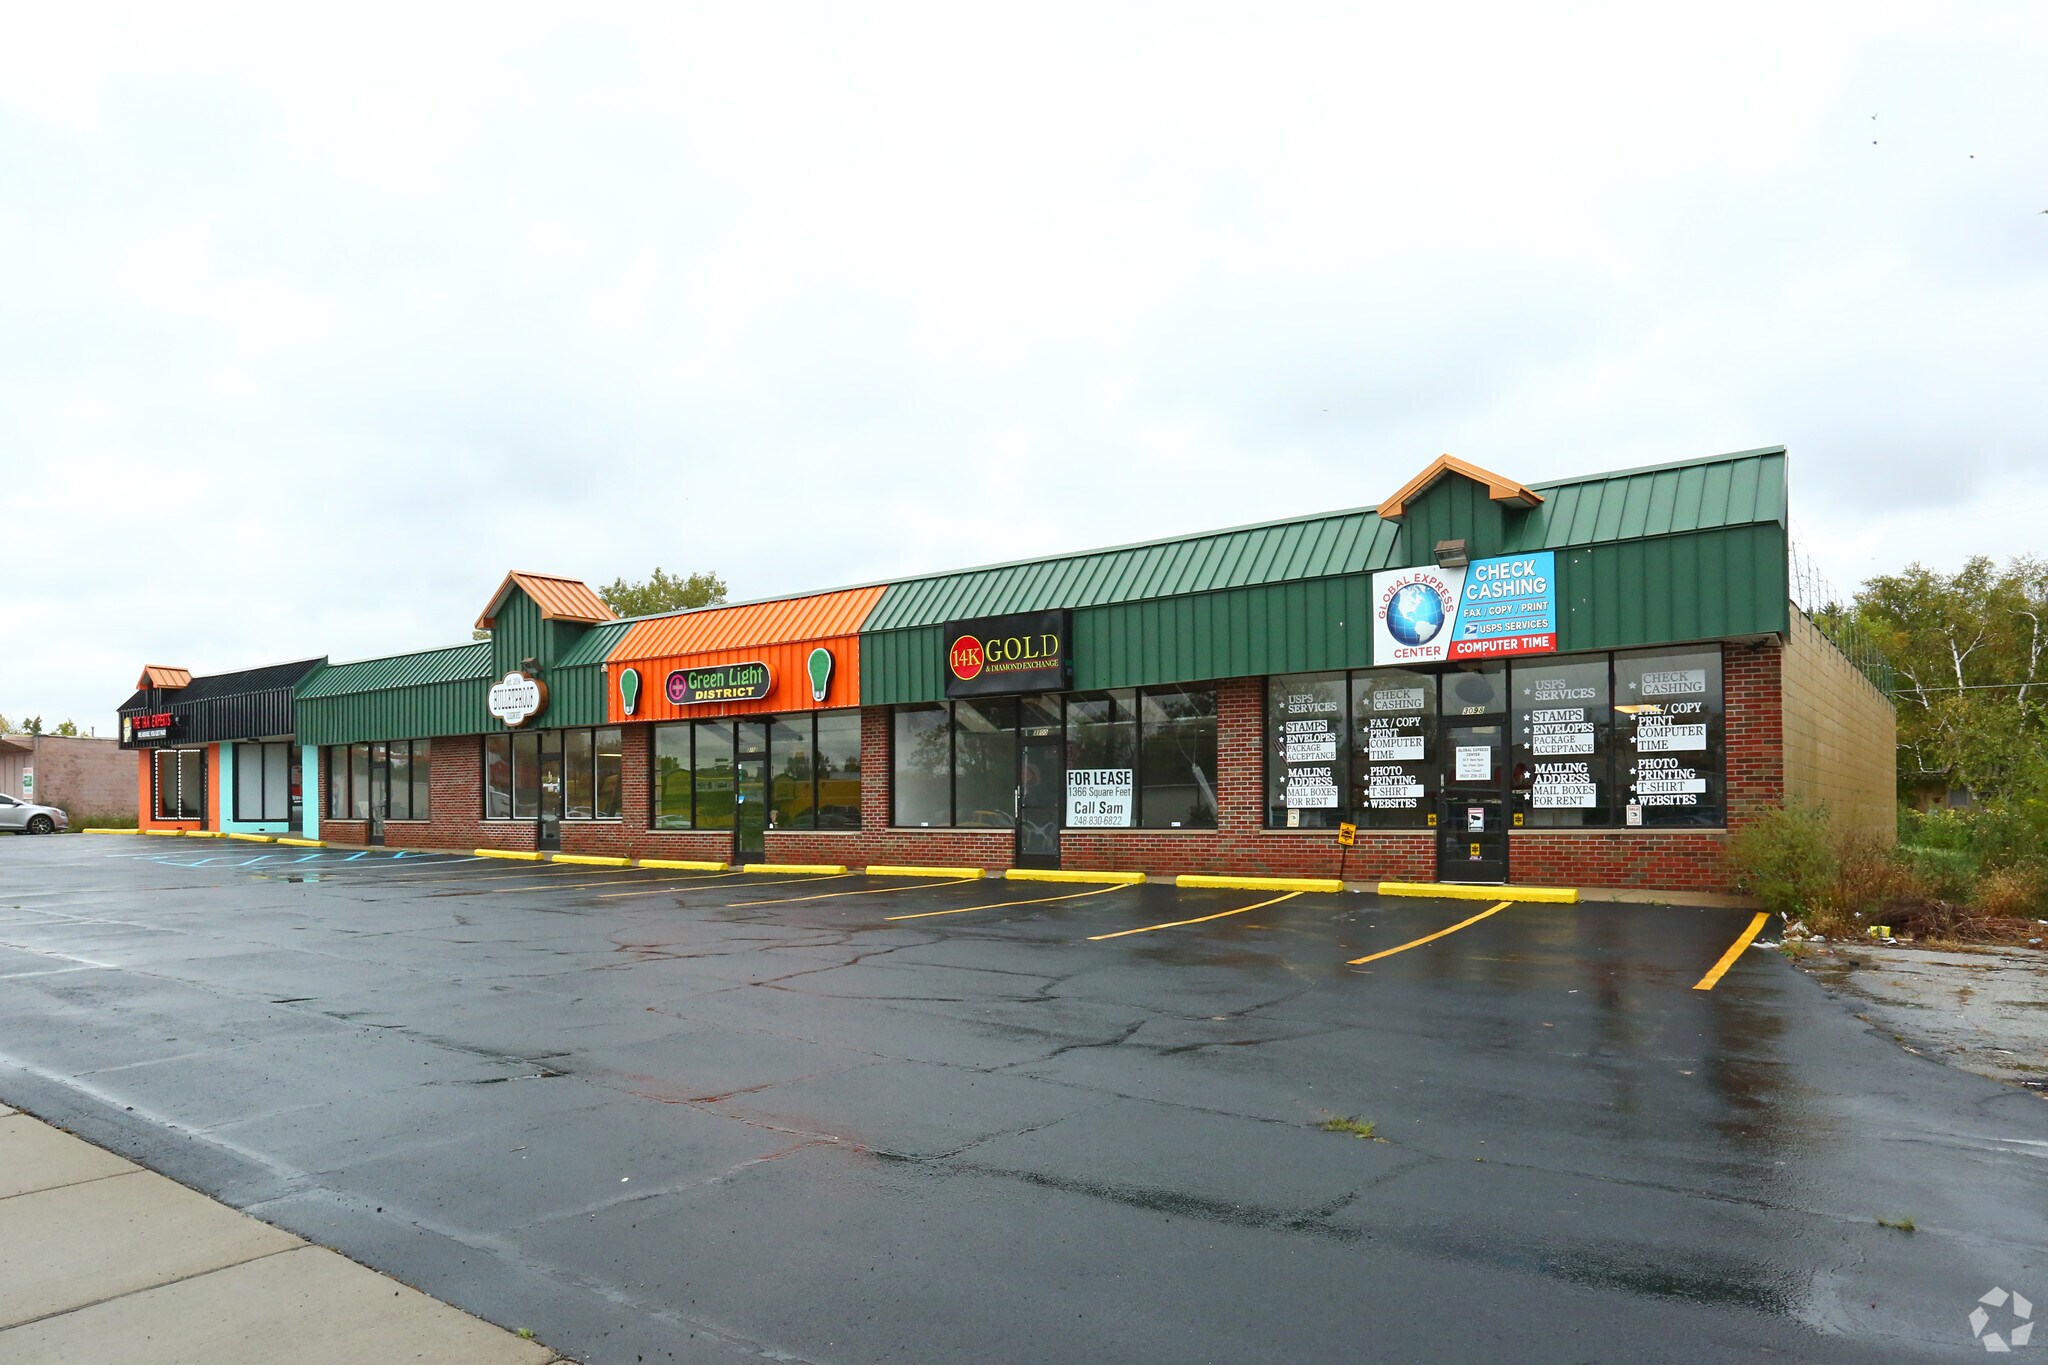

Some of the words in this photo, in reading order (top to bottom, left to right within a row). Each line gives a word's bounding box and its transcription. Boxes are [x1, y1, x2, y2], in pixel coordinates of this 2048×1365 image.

[1475, 560, 1536, 582] CHECK
[1466, 577, 1546, 600] CASHING
[1378, 576, 1410, 620] GLOBAL
[1414, 574, 1454, 612] EXPRESS
[1464, 608, 1481, 618] FAX
[1490, 605, 1512, 616] COPY
[1521, 602, 1548, 612] PRINT
[1480, 623, 1502, 633] USPS
[1504, 620, 1548, 631] SERVICES
[953, 648, 980, 667] 14K
[985, 634, 1058, 662] GOLD
[1456, 639, 1518, 654] COMPUTER
[1521, 636, 1550, 648] TIME
[1394, 646, 1440, 658] CENTER
[992, 662, 1022, 670] DIAMOND
[1023, 660, 1058, 669] EXCHANGE
[688, 672, 724, 690] Green
[729, 666, 763, 686] Light
[1643, 672, 1688, 684] CHECK
[1536, 679, 1566, 690] USPS
[1643, 682, 1702, 694] CASHING
[695, 687, 754, 700] DISTRICT
[1288, 694, 1313, 704] USPS
[1374, 690, 1410, 700] CHECK
[1534, 688, 1596, 700] SERVICES
[1288, 702, 1337, 714] SERVICES
[1374, 699, 1422, 710] CASHING
[1670, 702, 1702, 714] COPY
[1534, 710, 1582, 722] STAMPS
[1638, 716, 1674, 726] PRINT
[1286, 722, 1326, 732] STAMPS
[1370, 718, 1389, 728] FAX
[1396, 717, 1421, 726] COPY
[1533, 722, 1594, 734] ENVELOPES
[1370, 728, 1399, 738] PRINT
[1638, 726, 1704, 738] COMPUTER
[1286, 733, 1336, 743] ENVELOPES
[1370, 738, 1422, 748] COMPUTER
[1534, 736, 1576, 744] PACKAGE
[1288, 744, 1321, 752] PACKAGE
[1534, 744, 1594, 754] ACCEPTANCE
[1638, 740, 1669, 750] TIME
[1287, 751, 1336, 760] ACCEPTANCE
[1370, 750, 1395, 759] TIME
[1534, 762, 1588, 774] MAILING
[1638, 758, 1678, 770] PHOTO
[1288, 768, 1331, 777] MAILING
[1370, 766, 1402, 776] PHOTO
[1638, 768, 1696, 780] PRINTING
[1068, 772, 1090, 785] FOR
[1094, 771, 1130, 785] LEASE
[1288, 777, 1332, 786] ADDRESS
[1370, 776, 1416, 785] PRINTING
[1534, 774, 1590, 784] ADDRESS
[1068, 787, 1087, 796] 1366
[1089, 787, 1113, 798] Square
[1116, 786, 1131, 796] Feet
[1287, 788, 1309, 796] MAIL
[1310, 787, 1337, 796] BOXES
[1371, 787, 1408, 796] T-SHIRT
[1534, 787, 1560, 795] MAIL
[1562, 785, 1595, 795] BOXES
[1638, 781, 1686, 792] T-SHIRT
[1305, 797, 1328, 806] RENT
[1370, 799, 1417, 809] WEBSITES
[1534, 797, 1554, 806] FOR
[1556, 796, 1584, 805] RENT
[1638, 794, 1697, 806] WEBSITES
[1075, 801, 1095, 814] Call
[1099, 801, 1123, 814] Sam
[1074, 816, 1122, 825] 248-830-6822
